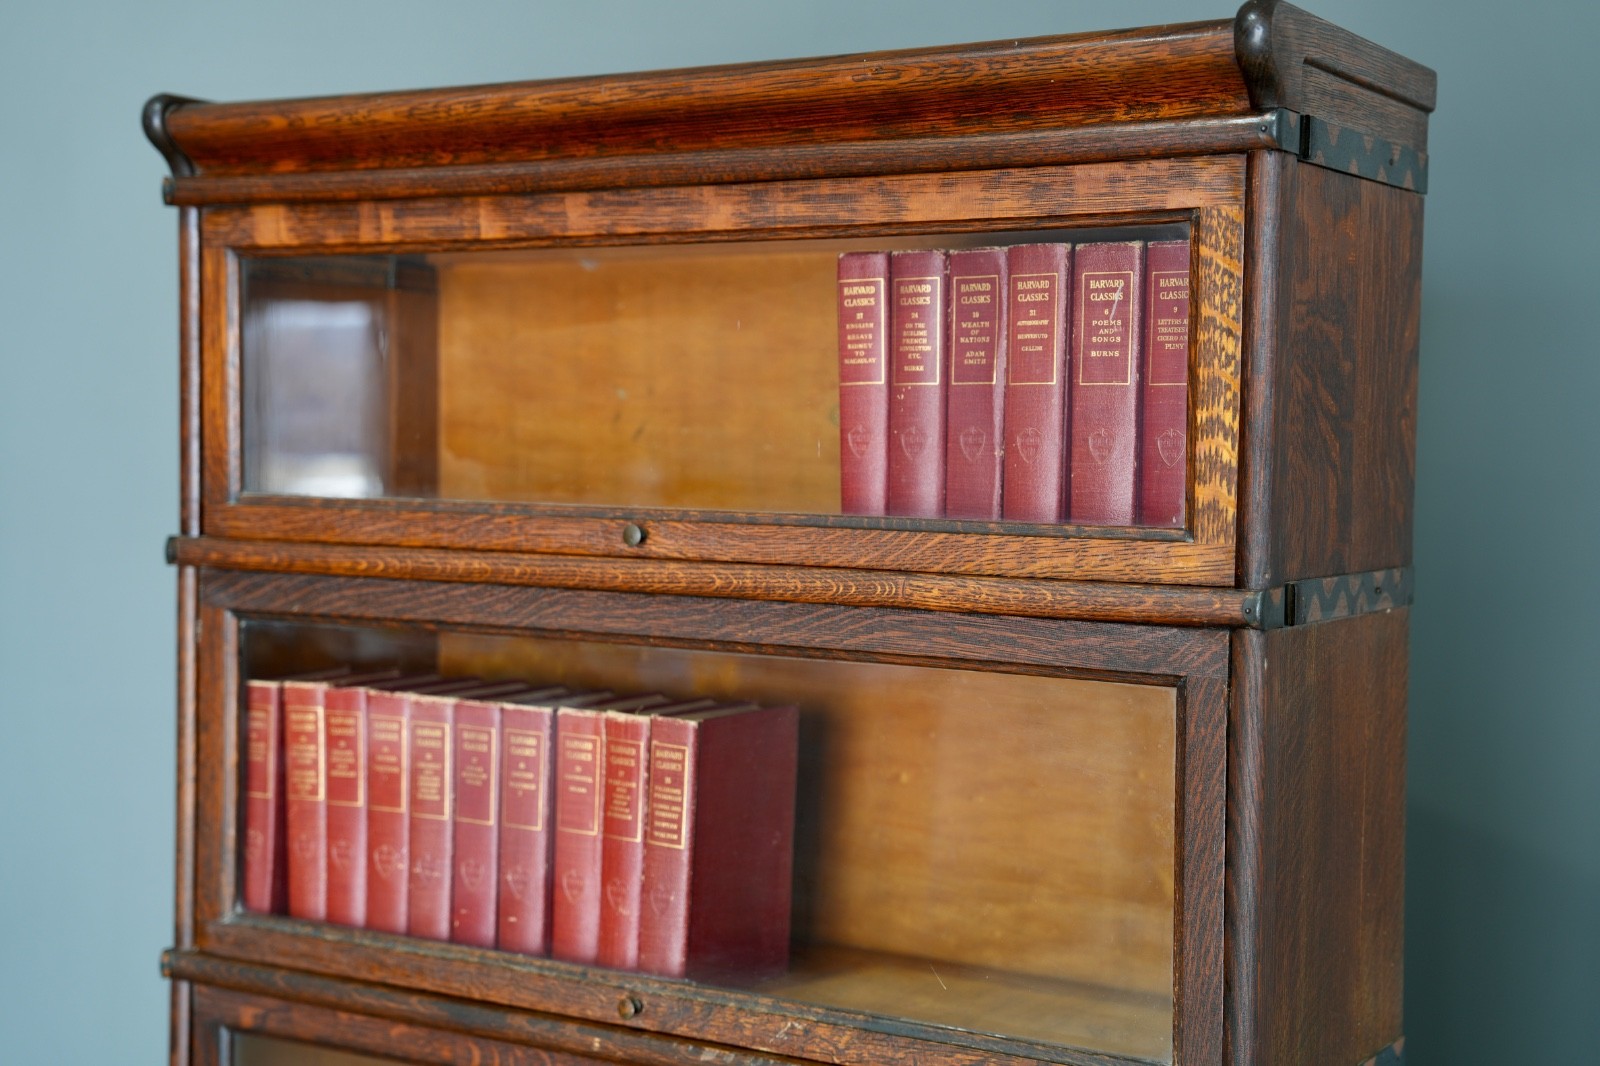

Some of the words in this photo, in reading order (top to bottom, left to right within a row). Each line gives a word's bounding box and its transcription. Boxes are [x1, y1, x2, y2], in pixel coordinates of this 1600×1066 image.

[1017, 280, 1049, 290] HARVARD
[1090, 280, 1124, 288] HARVARD
[1160, 278, 1188, 287] HARVAR
[844, 286, 875, 296] HARVARD
[900, 285, 931, 294] HARVARD
[961, 283, 991, 292] HARVARD
[1018, 293, 1049, 302] CLASSICS
[1160, 291, 1188, 299] CLASSIC
[844, 298, 875, 306] CLASSICS
[901, 297, 930, 305] CLASSICS
[961, 296, 990, 304] CLASSICS
